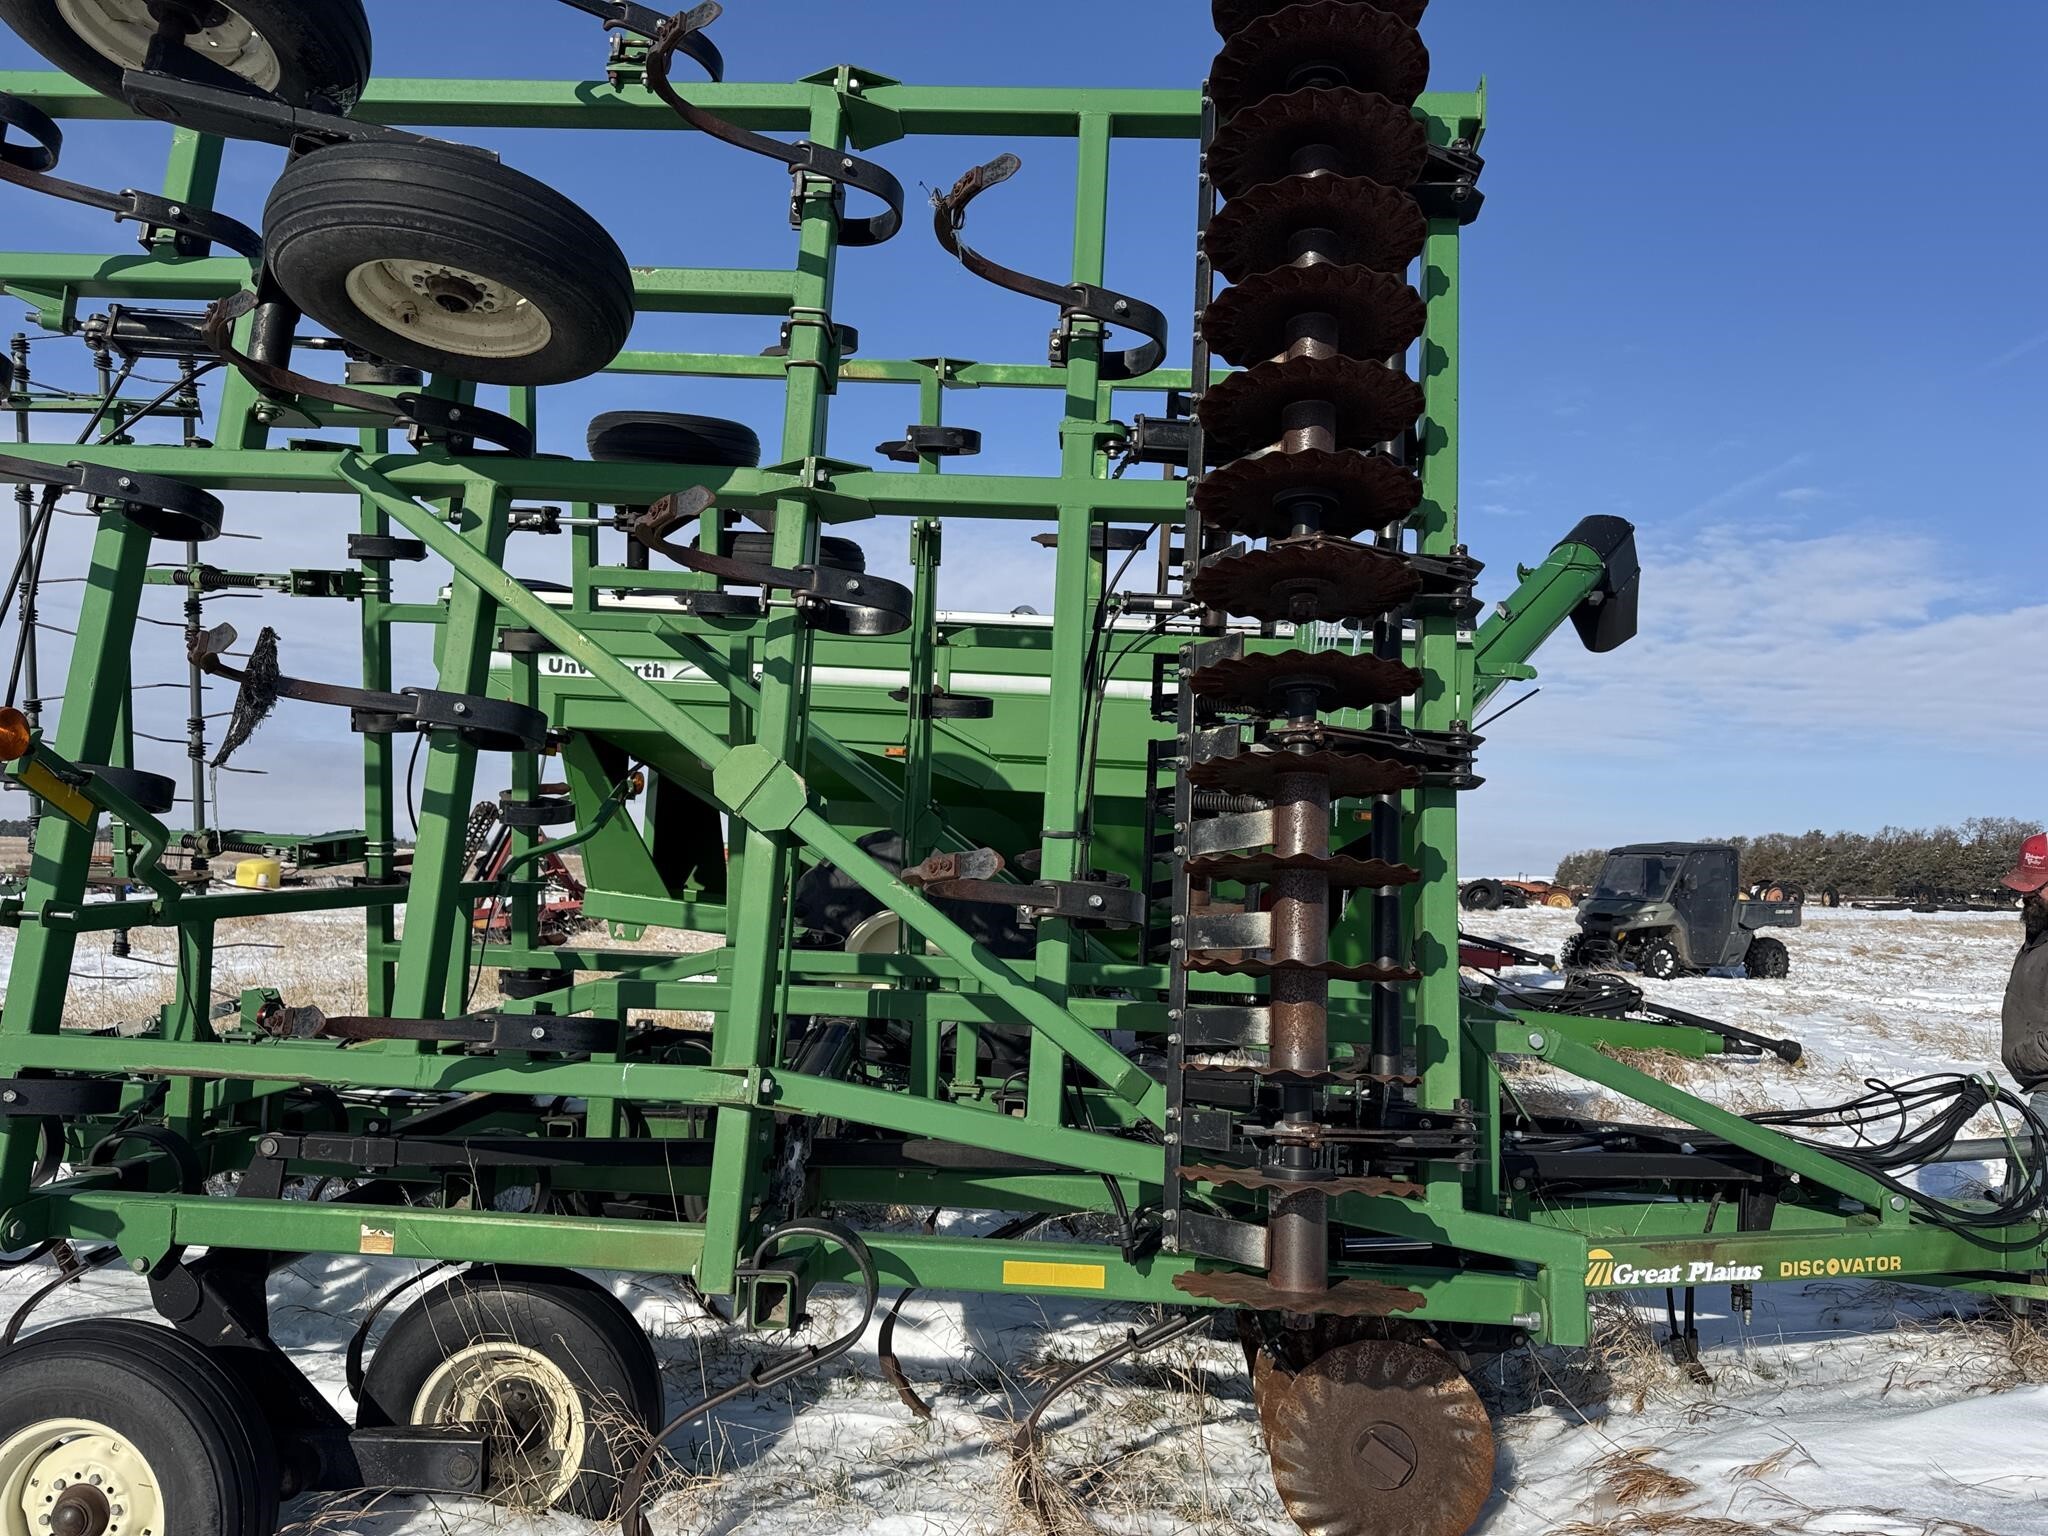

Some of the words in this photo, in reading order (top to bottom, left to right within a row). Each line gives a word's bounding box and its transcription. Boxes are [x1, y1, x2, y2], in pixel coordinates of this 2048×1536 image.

[1612, 1263, 1683, 1285] Great
[1685, 1260, 1763, 1282] Plains
[1780, 1256, 1902, 1277] DISCOVATOR
